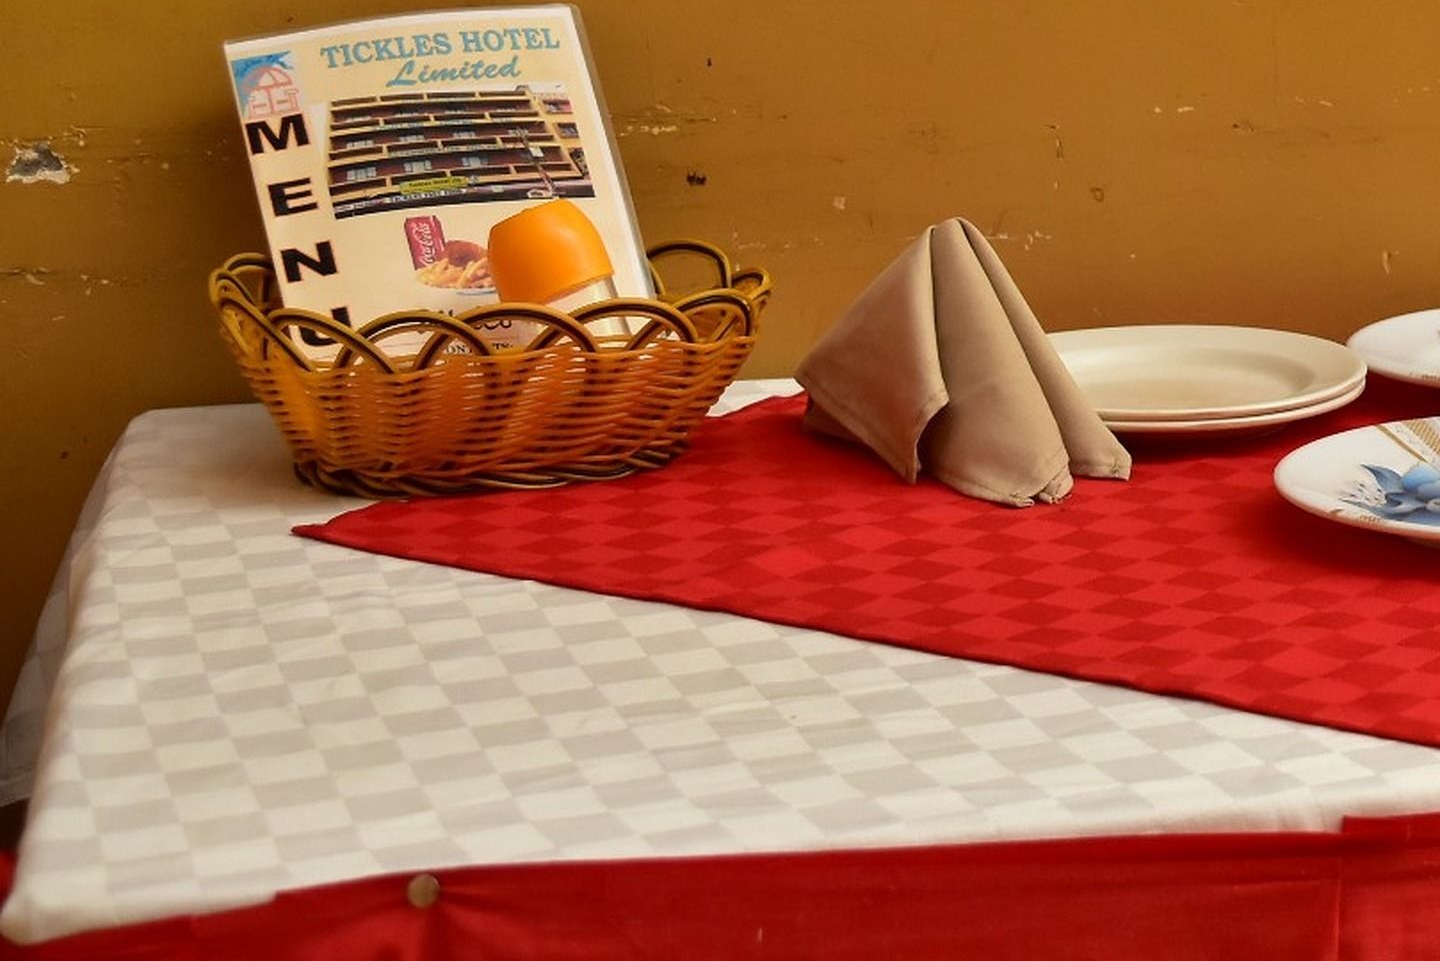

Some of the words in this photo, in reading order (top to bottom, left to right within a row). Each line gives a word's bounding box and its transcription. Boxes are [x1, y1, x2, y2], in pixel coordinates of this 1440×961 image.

[320, 32, 452, 69] TICKLES
[459, 28, 560, 53] HOTEL
[385, 55, 522, 88] Limited
